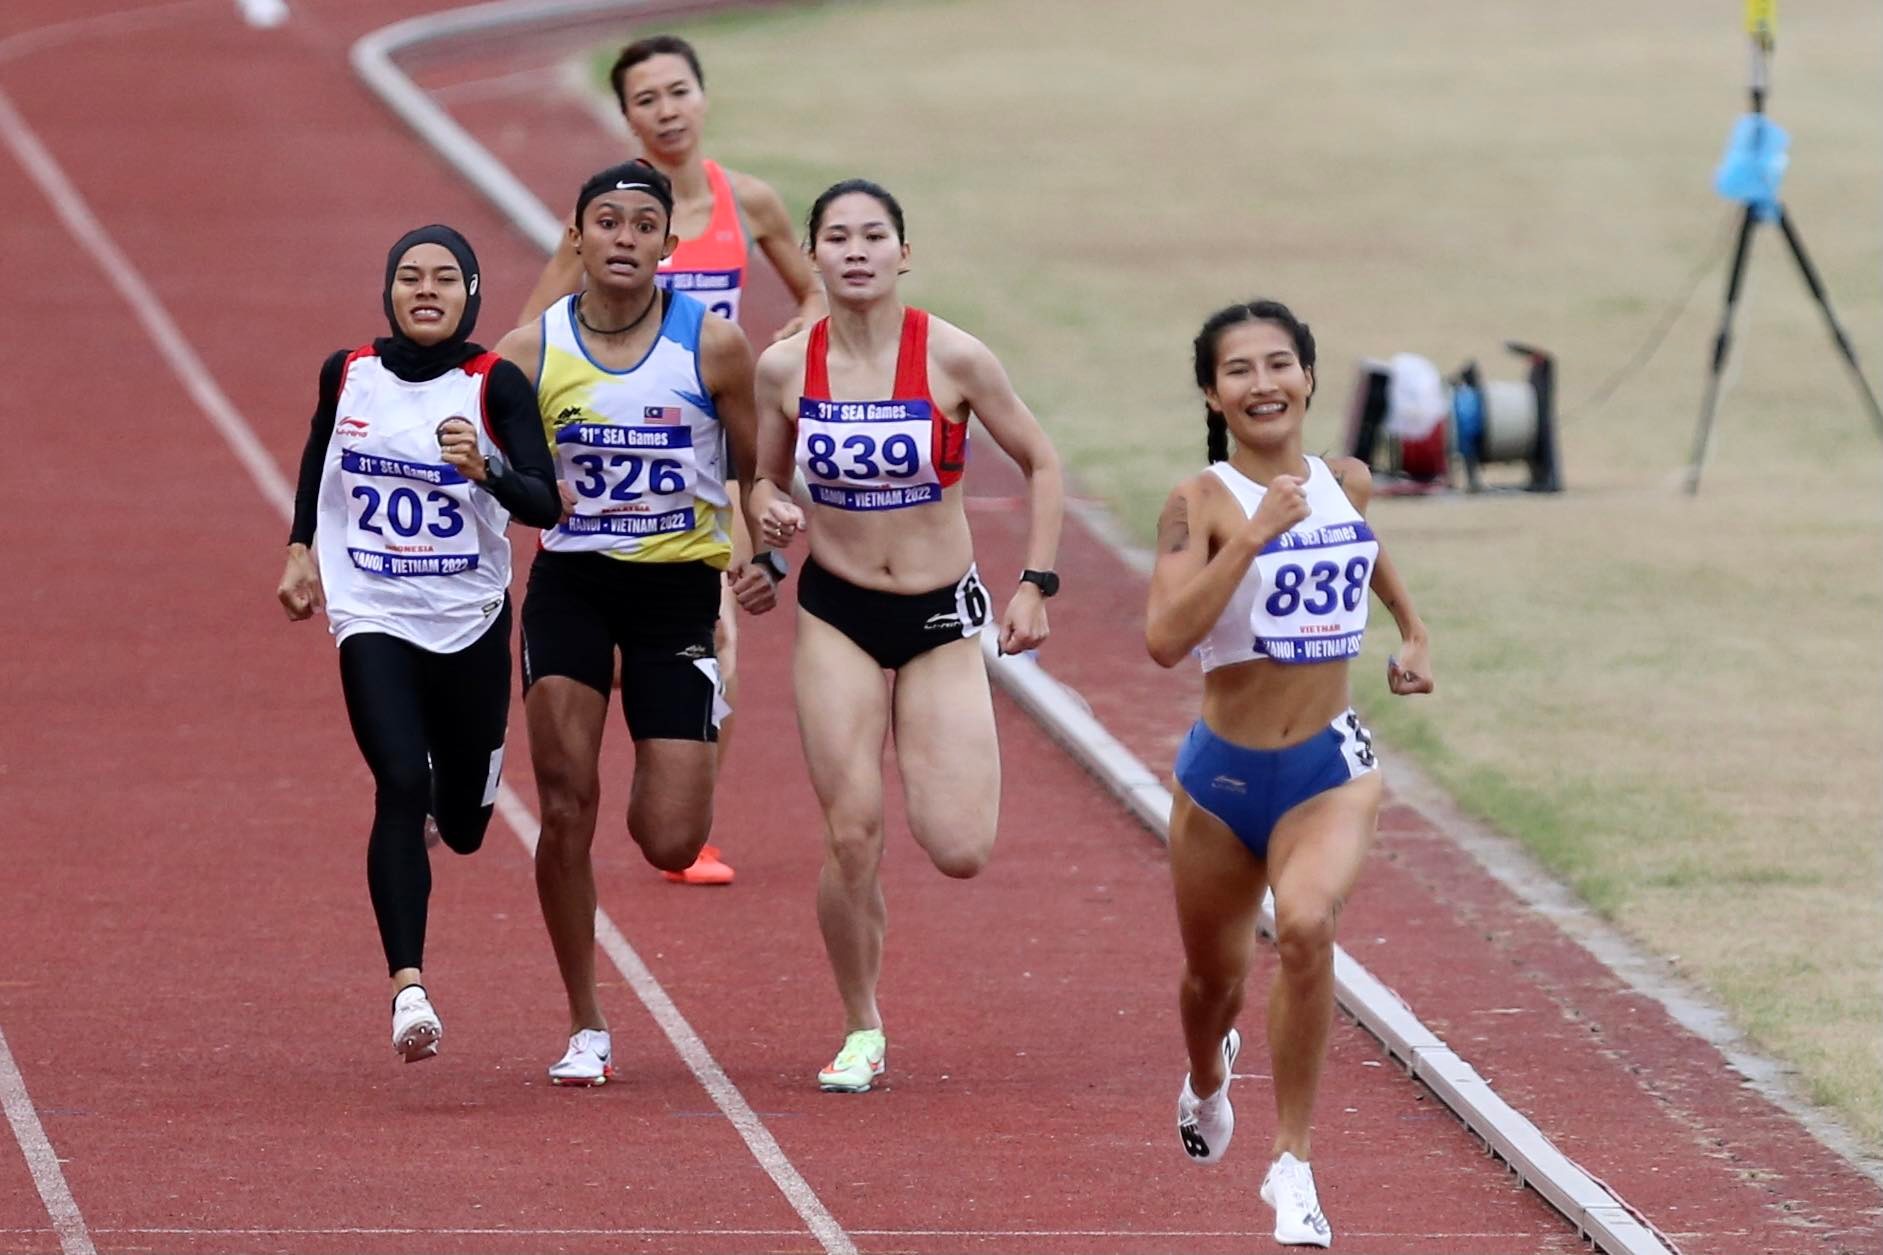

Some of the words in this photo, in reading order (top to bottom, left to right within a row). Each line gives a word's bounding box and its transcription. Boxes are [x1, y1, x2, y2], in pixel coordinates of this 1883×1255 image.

[841, 404, 864, 420] SEA
[867, 404, 906, 420] Games
[602, 428, 626, 445] SEA
[628, 429, 668, 446] Games
[808, 433, 920, 480] 839
[380, 460, 402, 475] SEA
[402, 464, 441, 483] Games
[571, 455, 686, 500] 326
[855, 490, 902, 507] VIETNAM
[904, 485, 931, 503] 2022
[352, 486, 464, 538] 203
[610, 518, 658, 533] VIETNAM
[660, 513, 686, 530] 2022
[1320, 525, 1357, 544] Games
[391, 558, 440, 574] VIETNAM
[1265, 556, 1370, 617] 838
[963, 575, 987, 627] 6
